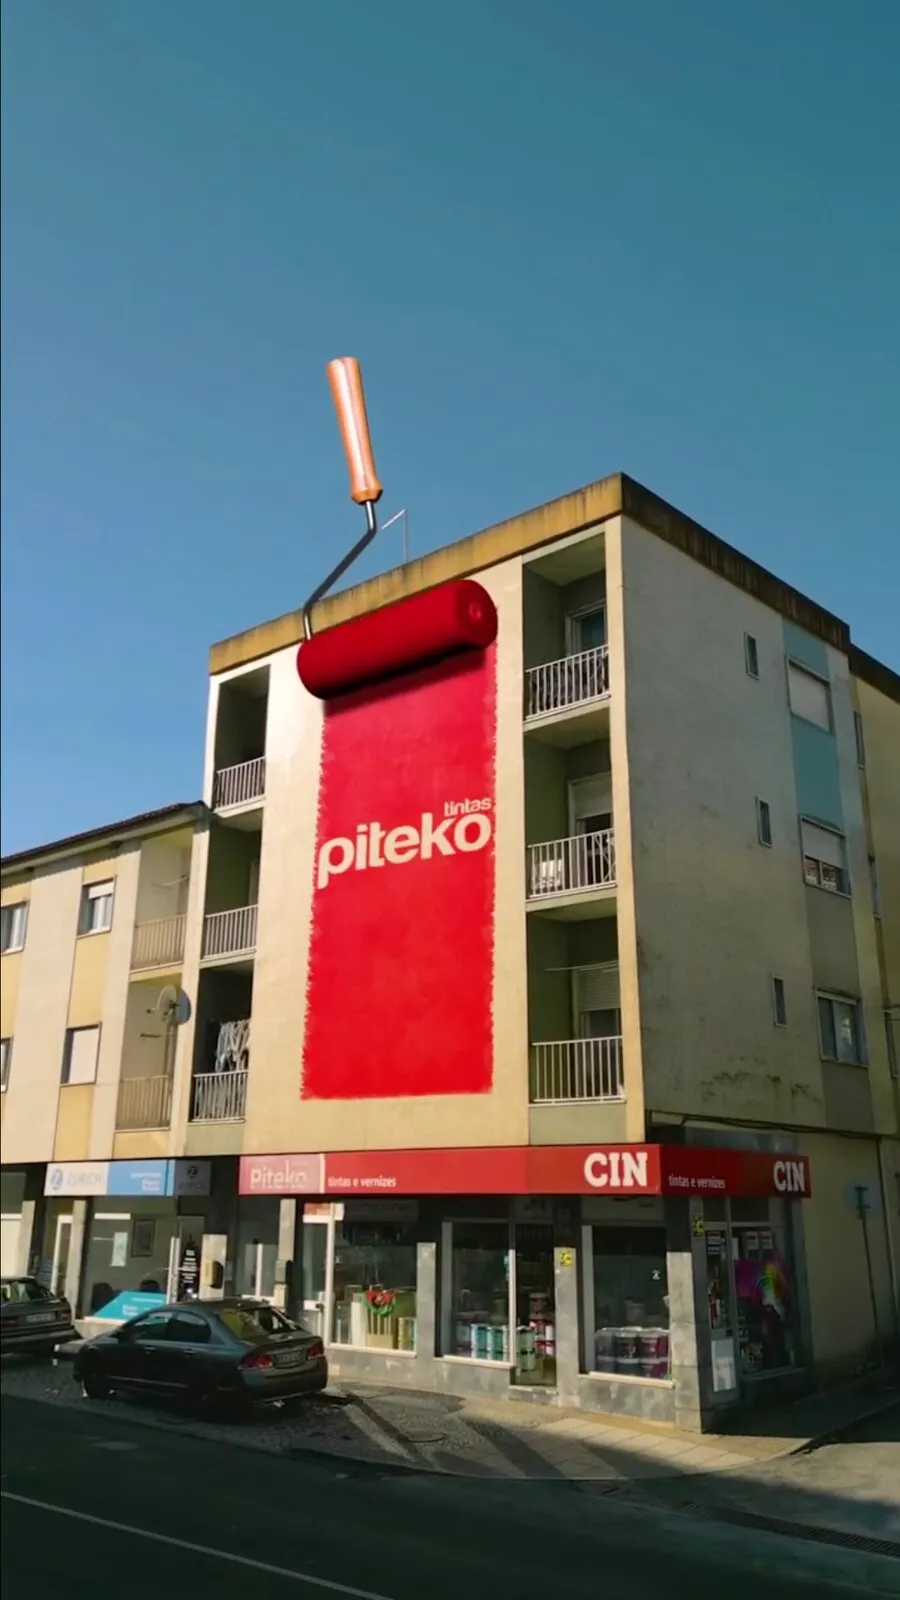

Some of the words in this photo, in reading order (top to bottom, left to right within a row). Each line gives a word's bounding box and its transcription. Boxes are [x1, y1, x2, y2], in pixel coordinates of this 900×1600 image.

[444, 797, 491, 817] tintas
[317, 812, 491, 889] piteko
[250, 1160, 307, 1189] Piteko
[328, 1176, 351, 1188] tintas
[353, 1178, 359, 1188] e
[360, 1175, 397, 1188] vernizes
[583, 1151, 648, 1188] CIN
[668, 1174, 689, 1188] tintas
[691, 1177, 696, 1188] e
[697, 1175, 726, 1189] vernizes
[773, 1160, 805, 1192] CIN
